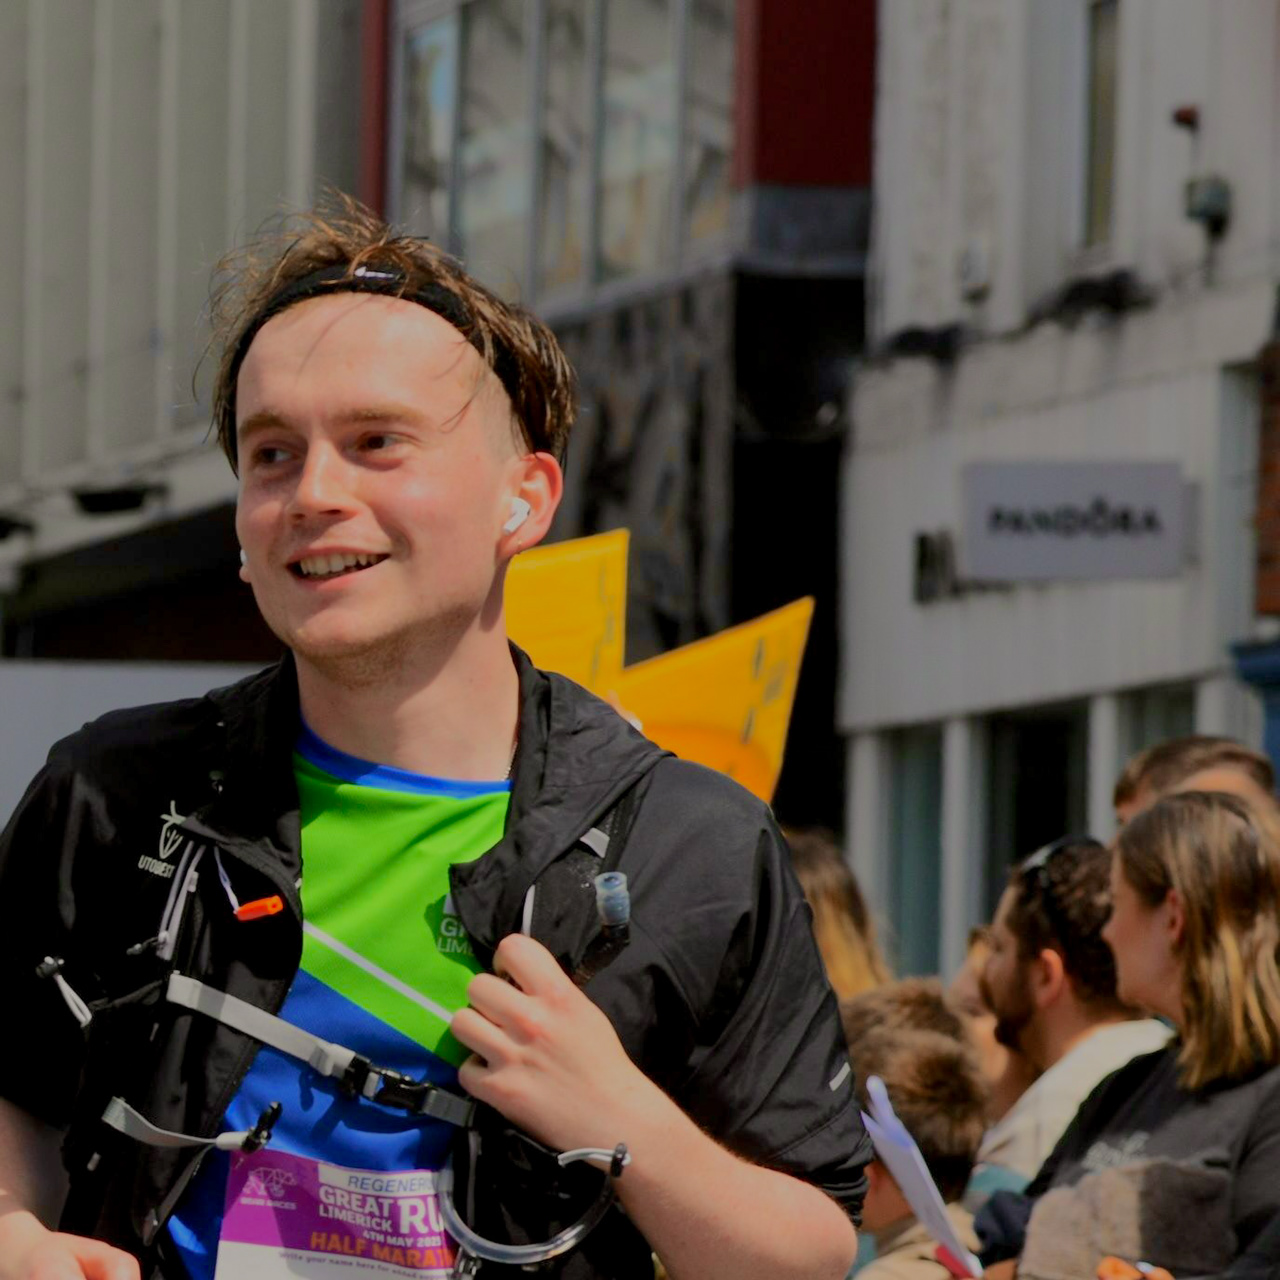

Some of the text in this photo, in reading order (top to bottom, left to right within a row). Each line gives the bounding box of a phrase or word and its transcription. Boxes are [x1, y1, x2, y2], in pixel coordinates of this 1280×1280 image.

[319, 1185, 393, 1218] GREAT
[397, 1197, 445, 1234] RU
[319, 1204, 393, 1232] LIMERICK
[310, 1231, 368, 1256] HALF
[363, 1230, 385, 1243] 4TH
[387, 1235, 414, 1248] MAY
